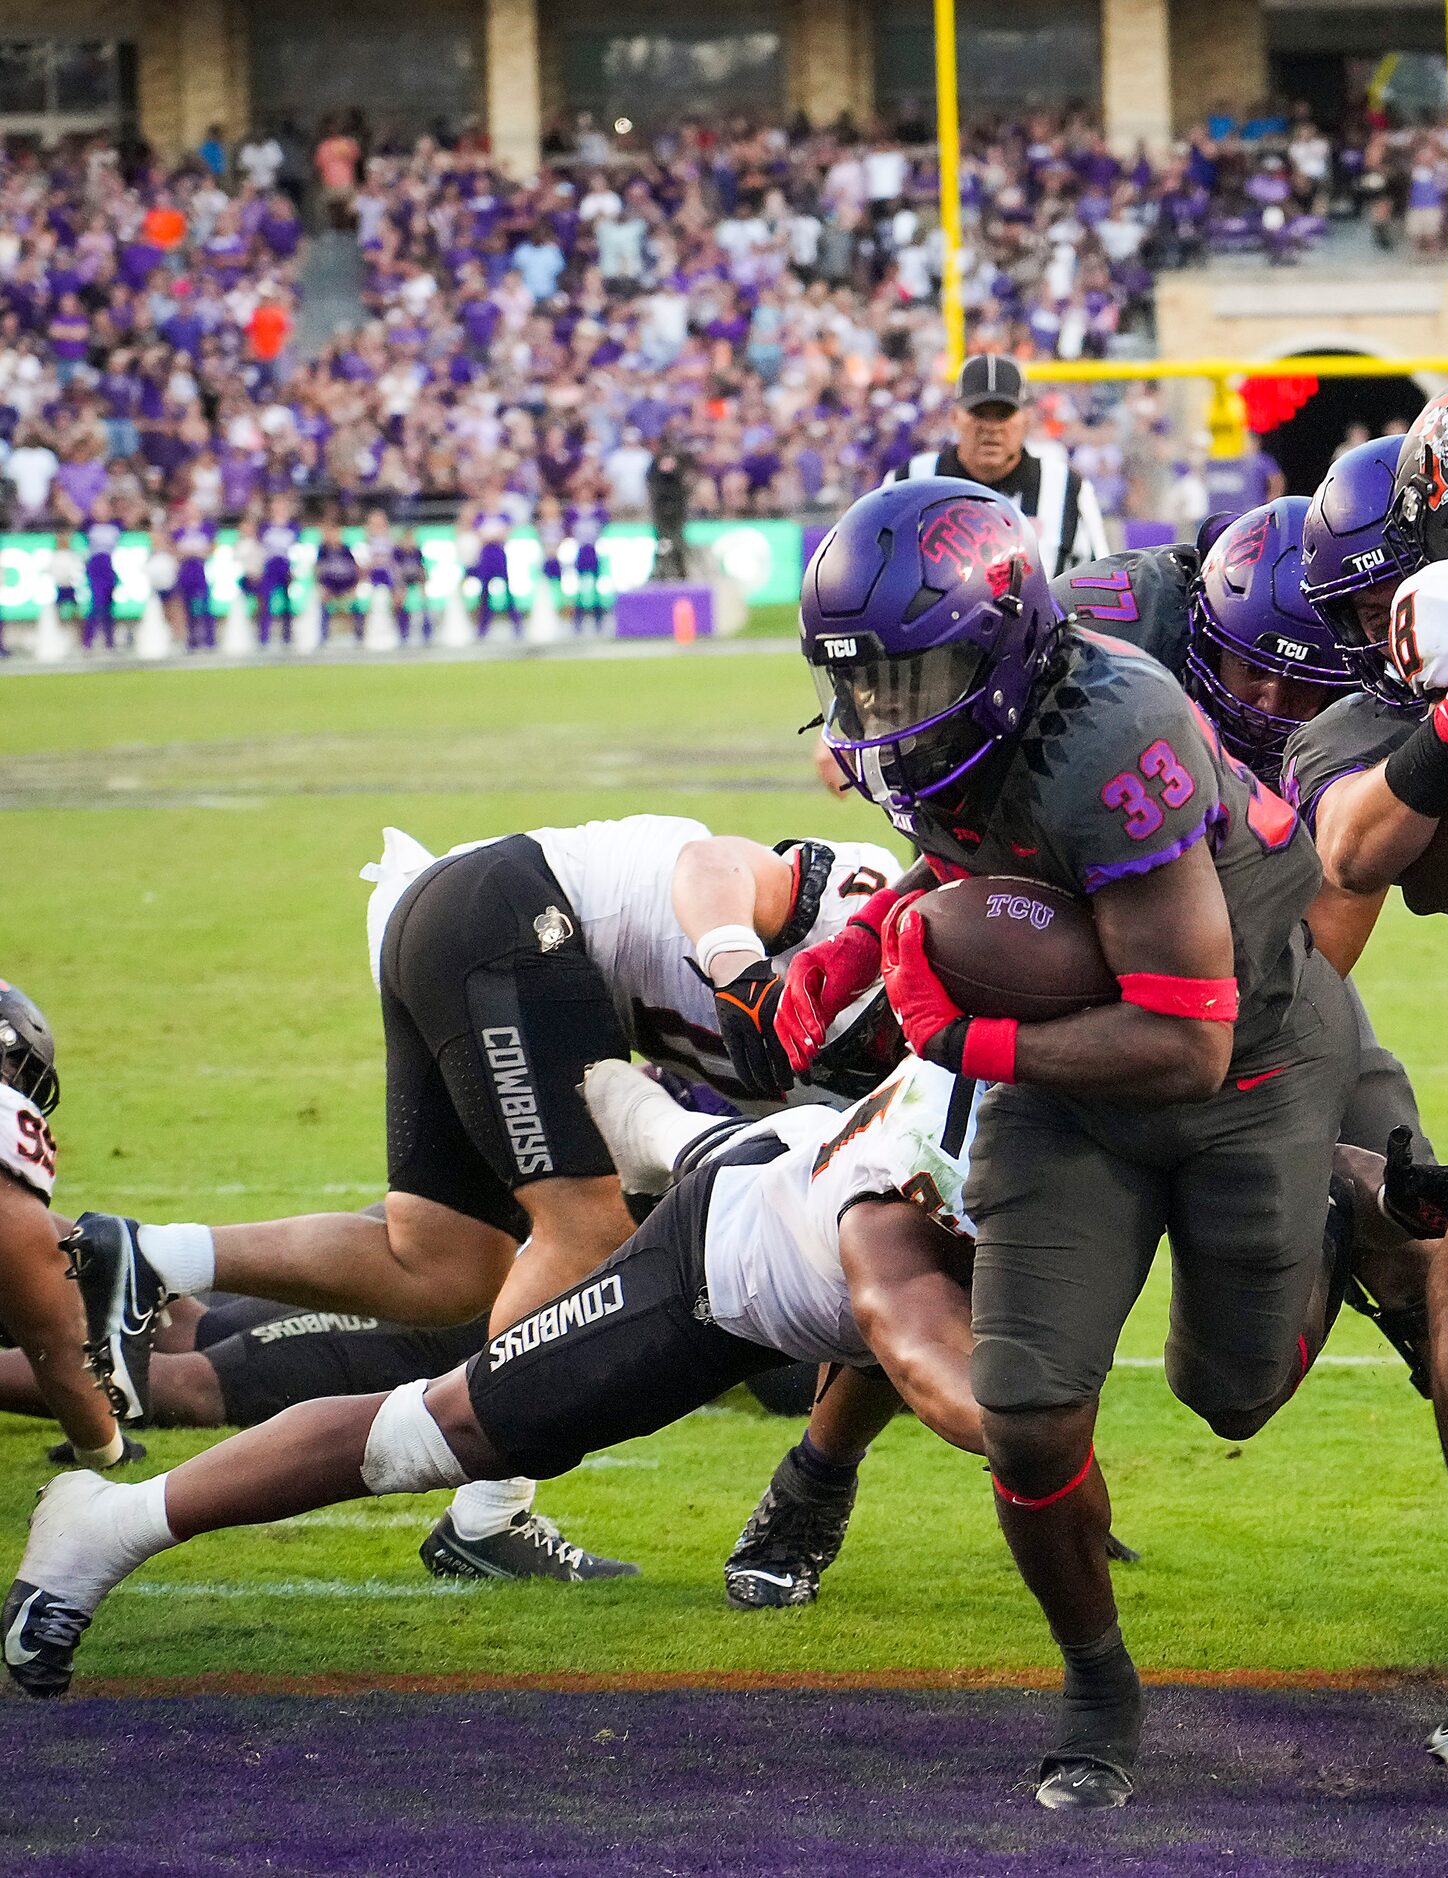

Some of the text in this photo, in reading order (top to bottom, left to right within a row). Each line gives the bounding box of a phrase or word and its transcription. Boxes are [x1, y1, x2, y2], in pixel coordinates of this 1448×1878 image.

[1351, 548, 1386, 574] TCU
[823, 637, 858, 659] TCU
[1275, 638, 1310, 661] TCU
[1100, 738, 1196, 842] 33
[986, 893, 1055, 930] TCU
[481, 1025, 554, 1175] COWBOYS
[489, 1273, 626, 1374] COWBOYS
